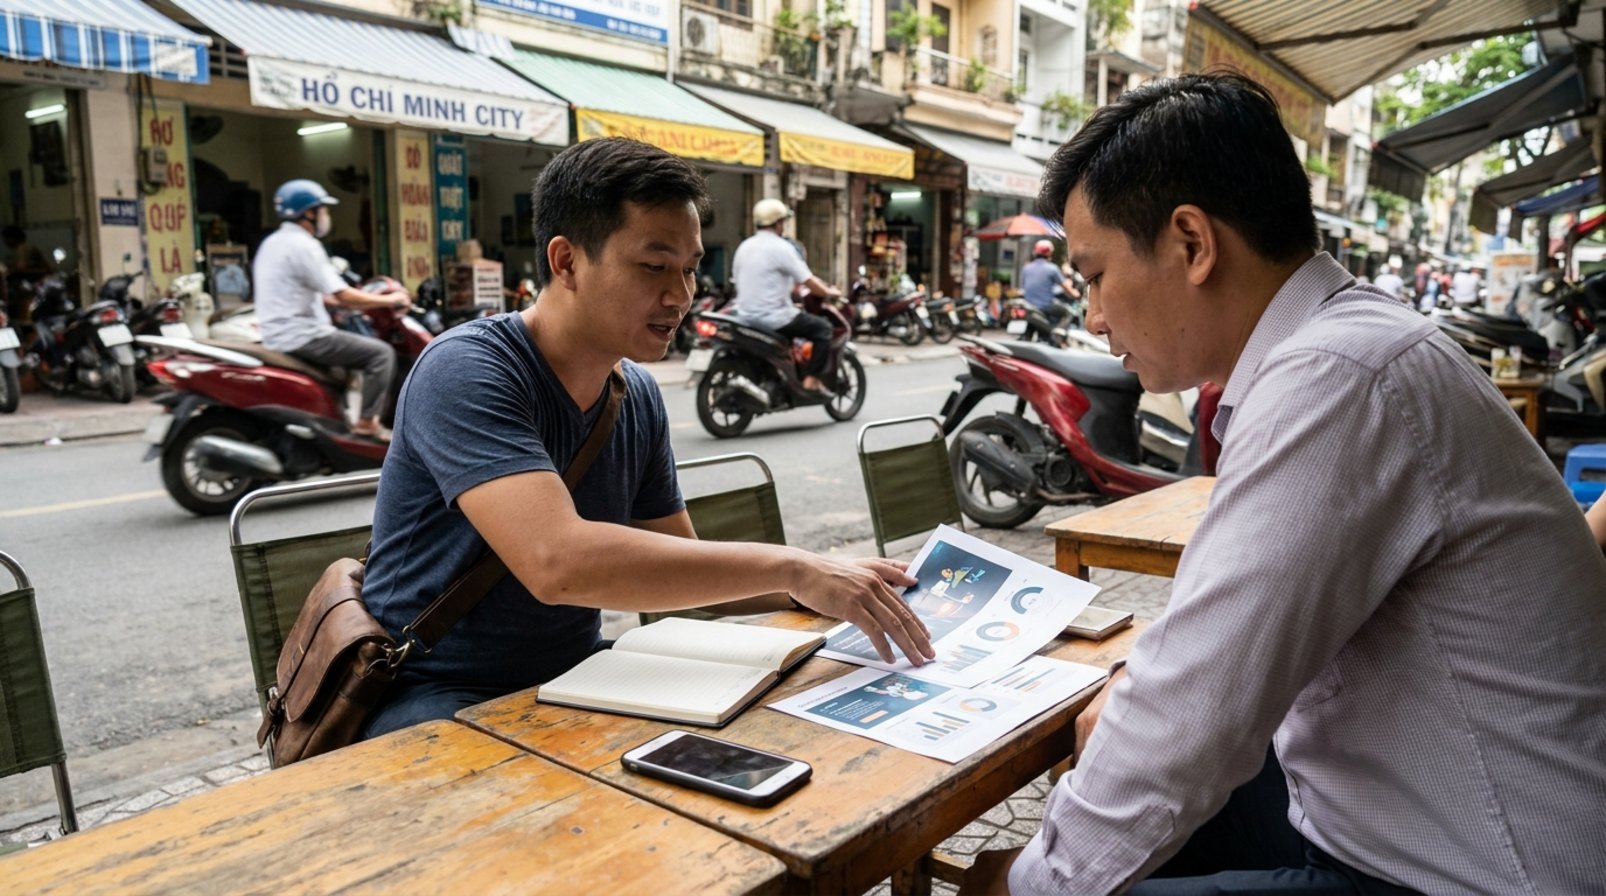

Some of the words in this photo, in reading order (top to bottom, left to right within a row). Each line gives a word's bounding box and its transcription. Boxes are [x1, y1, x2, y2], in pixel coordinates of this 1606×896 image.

[301, 72, 339, 106] HỒ
[351, 85, 394, 113] CHÍ
[405, 95, 466, 122] MINH
[476, 105, 524, 130] CITY
